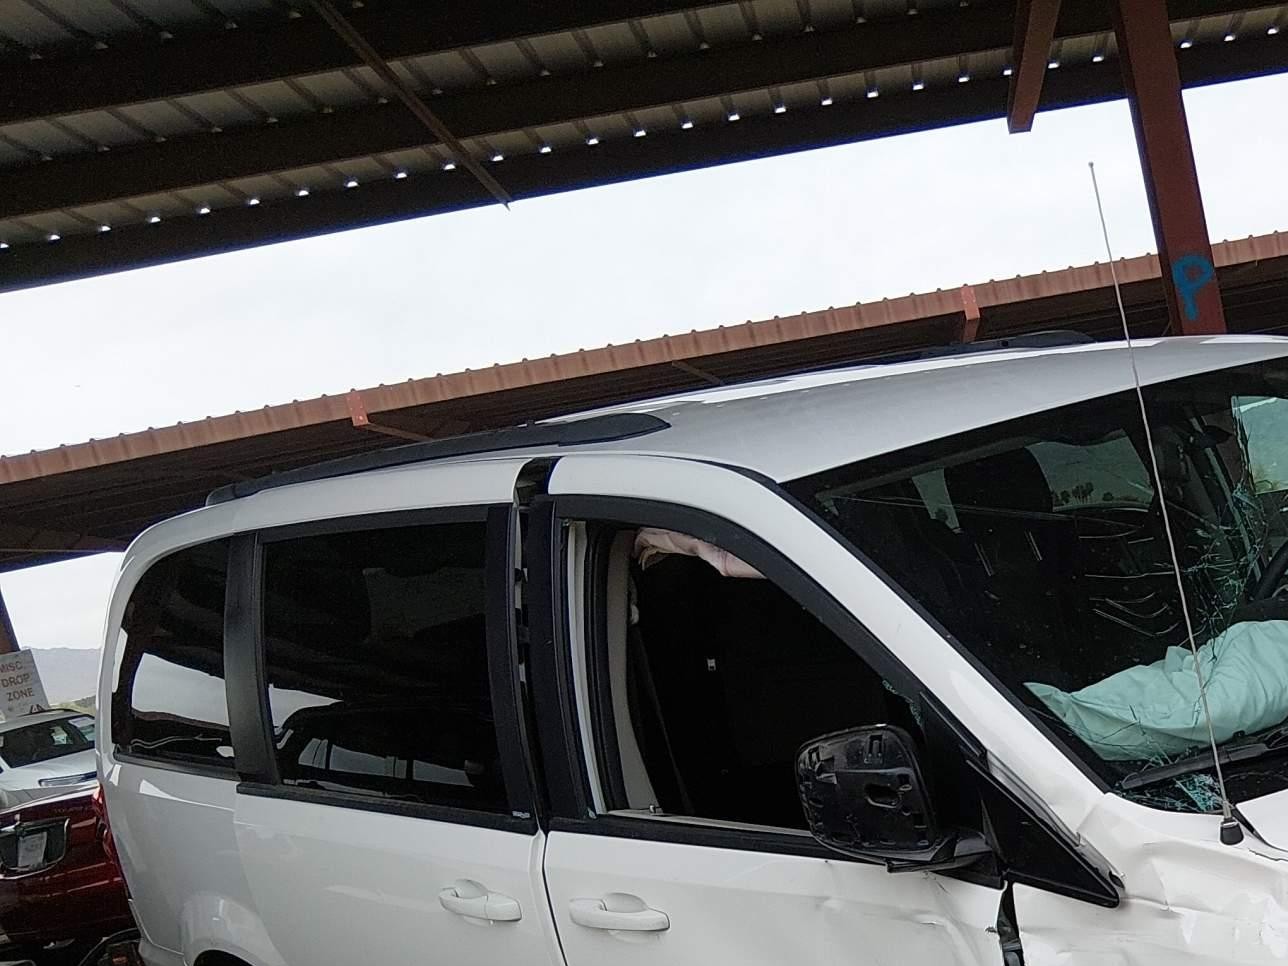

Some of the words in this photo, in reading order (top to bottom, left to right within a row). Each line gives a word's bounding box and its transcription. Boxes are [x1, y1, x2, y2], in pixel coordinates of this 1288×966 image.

[1171, 254, 1215, 321] P
[1, 673, 30, 688] DROP
[7, 688, 35, 702] ZONE
